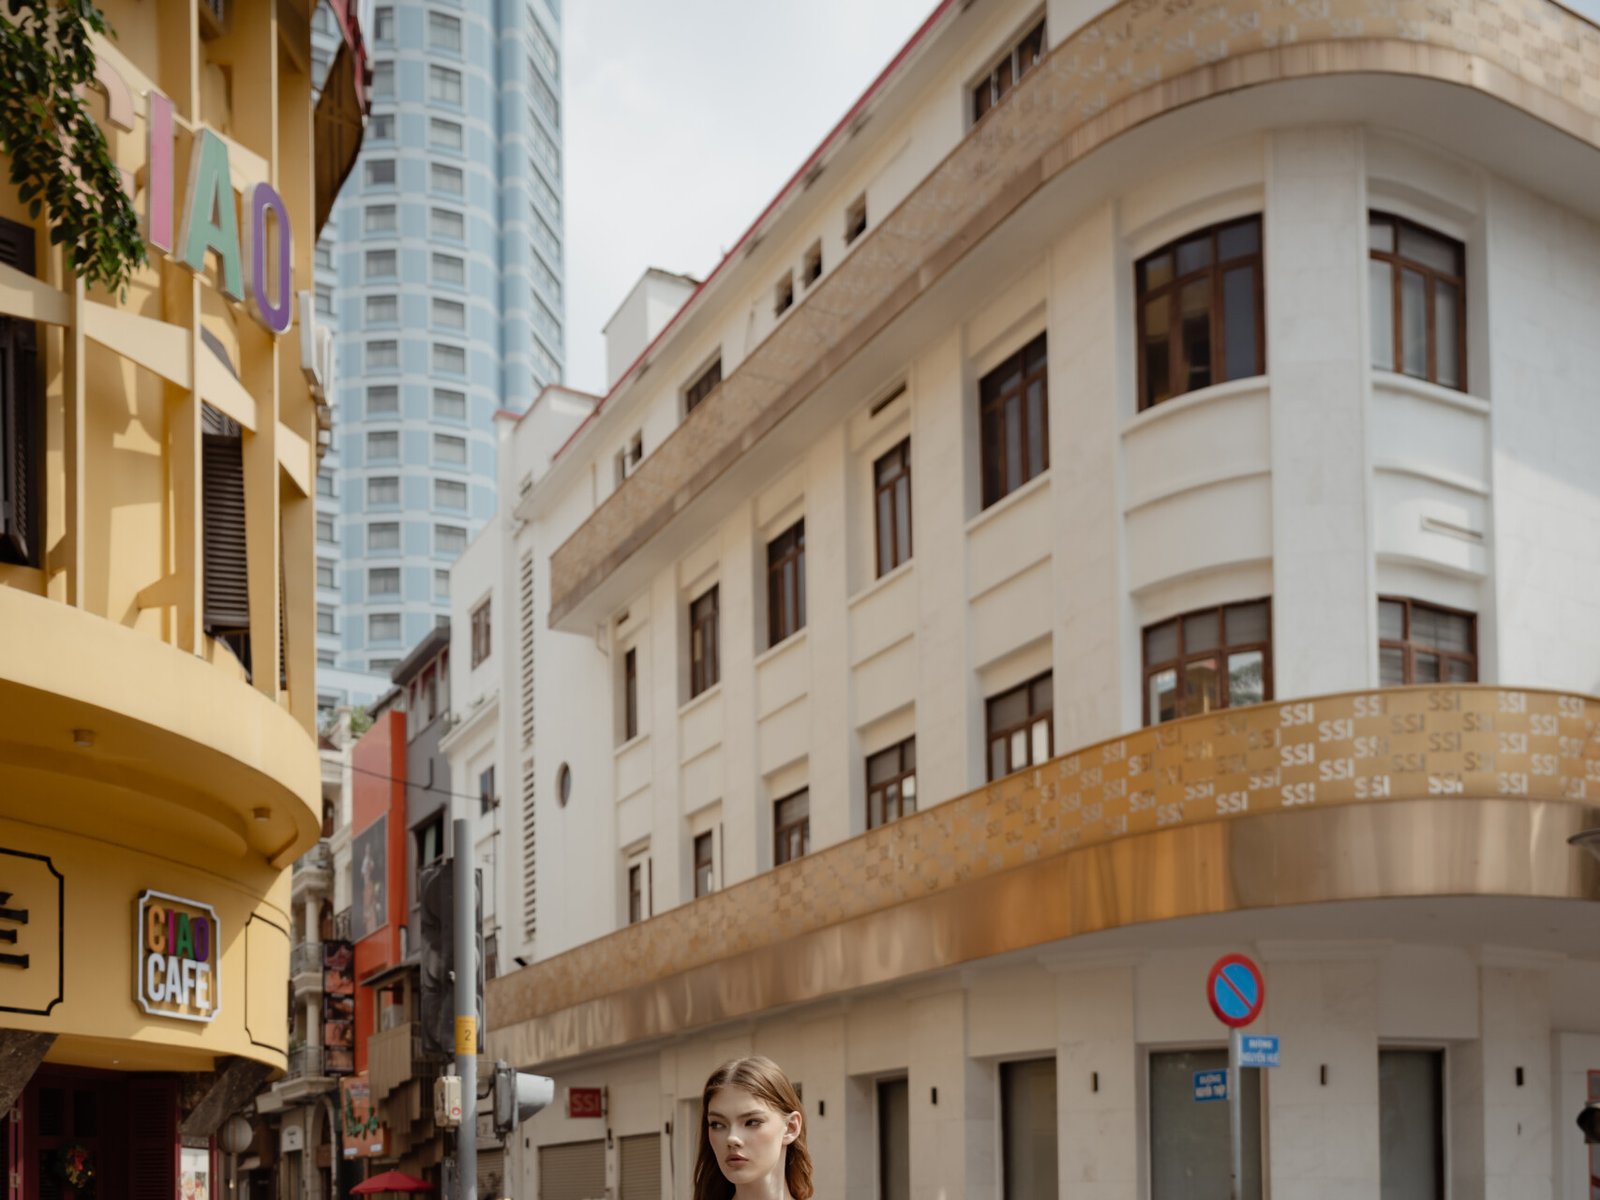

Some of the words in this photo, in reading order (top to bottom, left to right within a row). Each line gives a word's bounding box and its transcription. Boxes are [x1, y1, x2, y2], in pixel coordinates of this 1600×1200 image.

[1280, 703, 1314, 727] SSI
[1318, 719, 1354, 742] SSI
[1280, 743, 1314, 767] SSI
[1319, 758, 1354, 781] SSI
[1281, 782, 1315, 806] SSI
[1354, 775, 1390, 798] SSI
[1216, 790, 1248, 815] SSI
[148, 904, 209, 962] CIAO
[147, 952, 210, 1009] CAFE
[464, 1029, 471, 1041] 2
[572, 1094, 600, 1112] SSI
